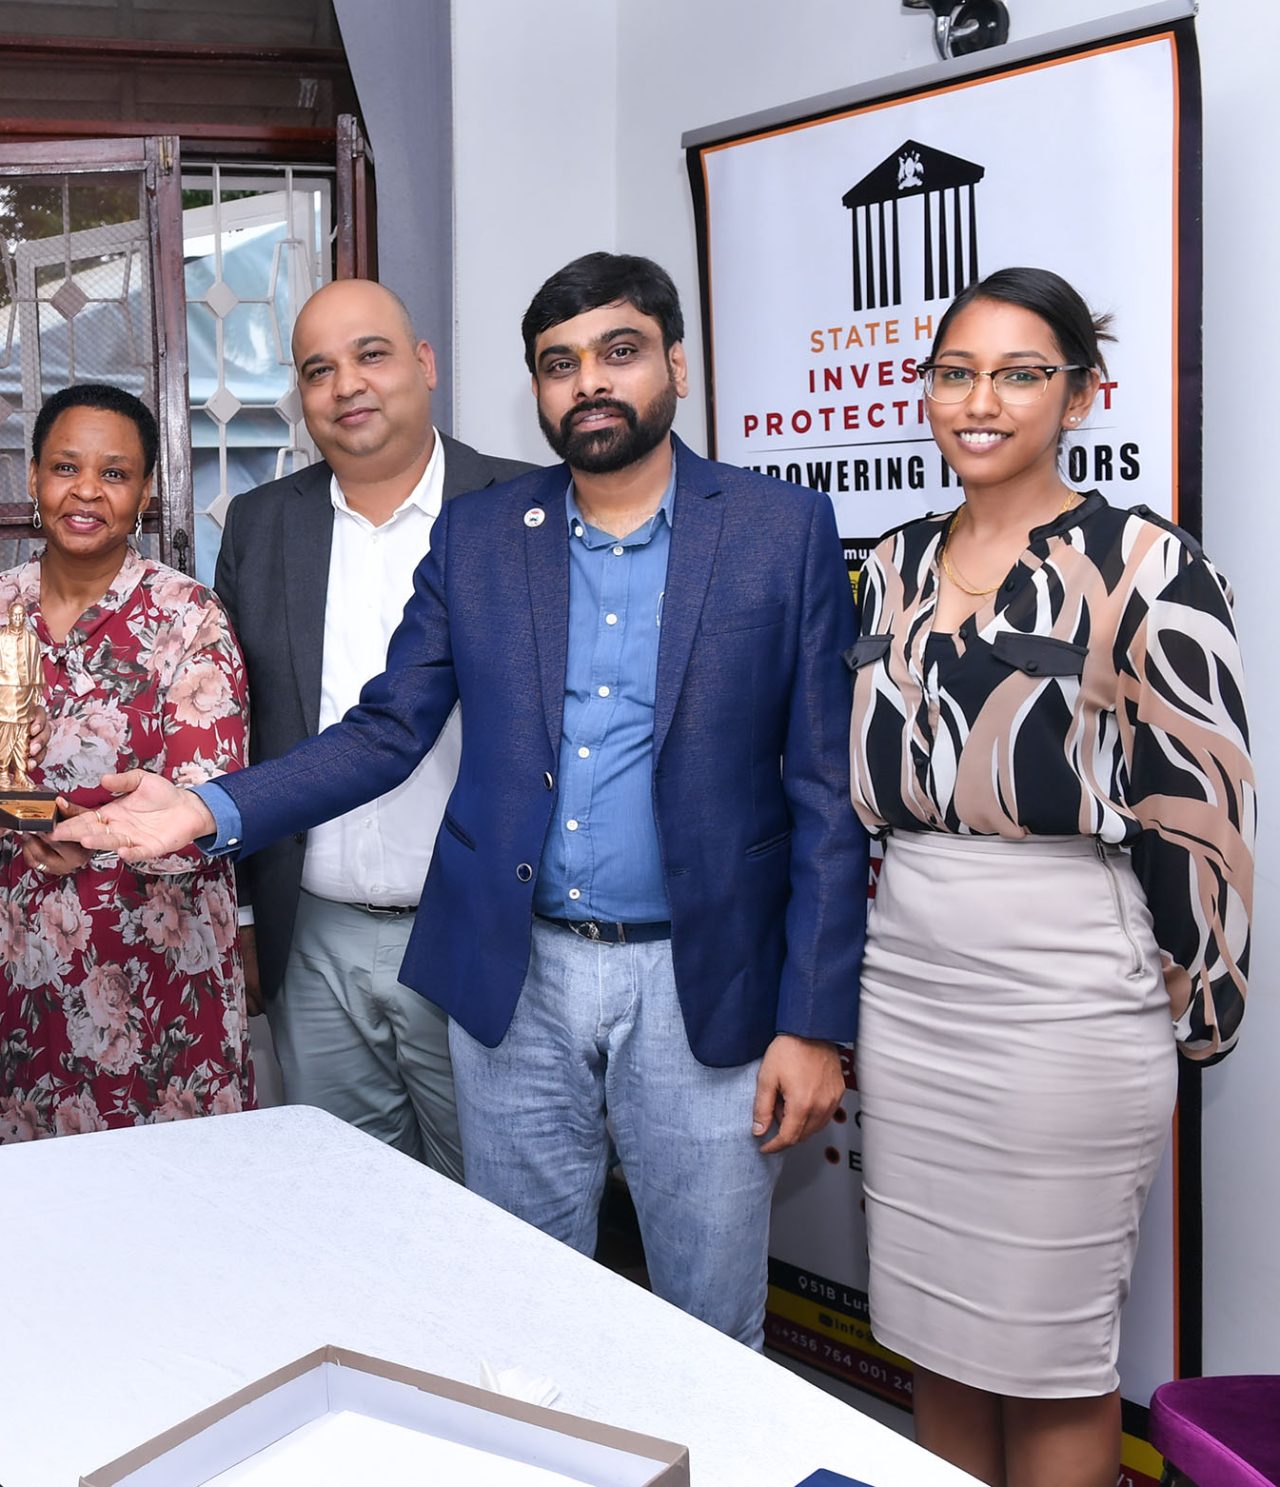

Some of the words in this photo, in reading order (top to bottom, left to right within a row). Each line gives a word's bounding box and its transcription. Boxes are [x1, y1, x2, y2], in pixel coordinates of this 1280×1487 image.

[810, 319, 900, 353] STATE
[914, 314, 933, 341] H
[809, 357, 929, 393] INVES
[744, 399, 924, 438] PROTECTI
[745, 456, 925, 492] POWERING
[810, 1280, 836, 1300] 51B
[834, 1318, 871, 1339] info
[858, 1360, 888, 1382] 001
[893, 1375, 913, 1393] 24
